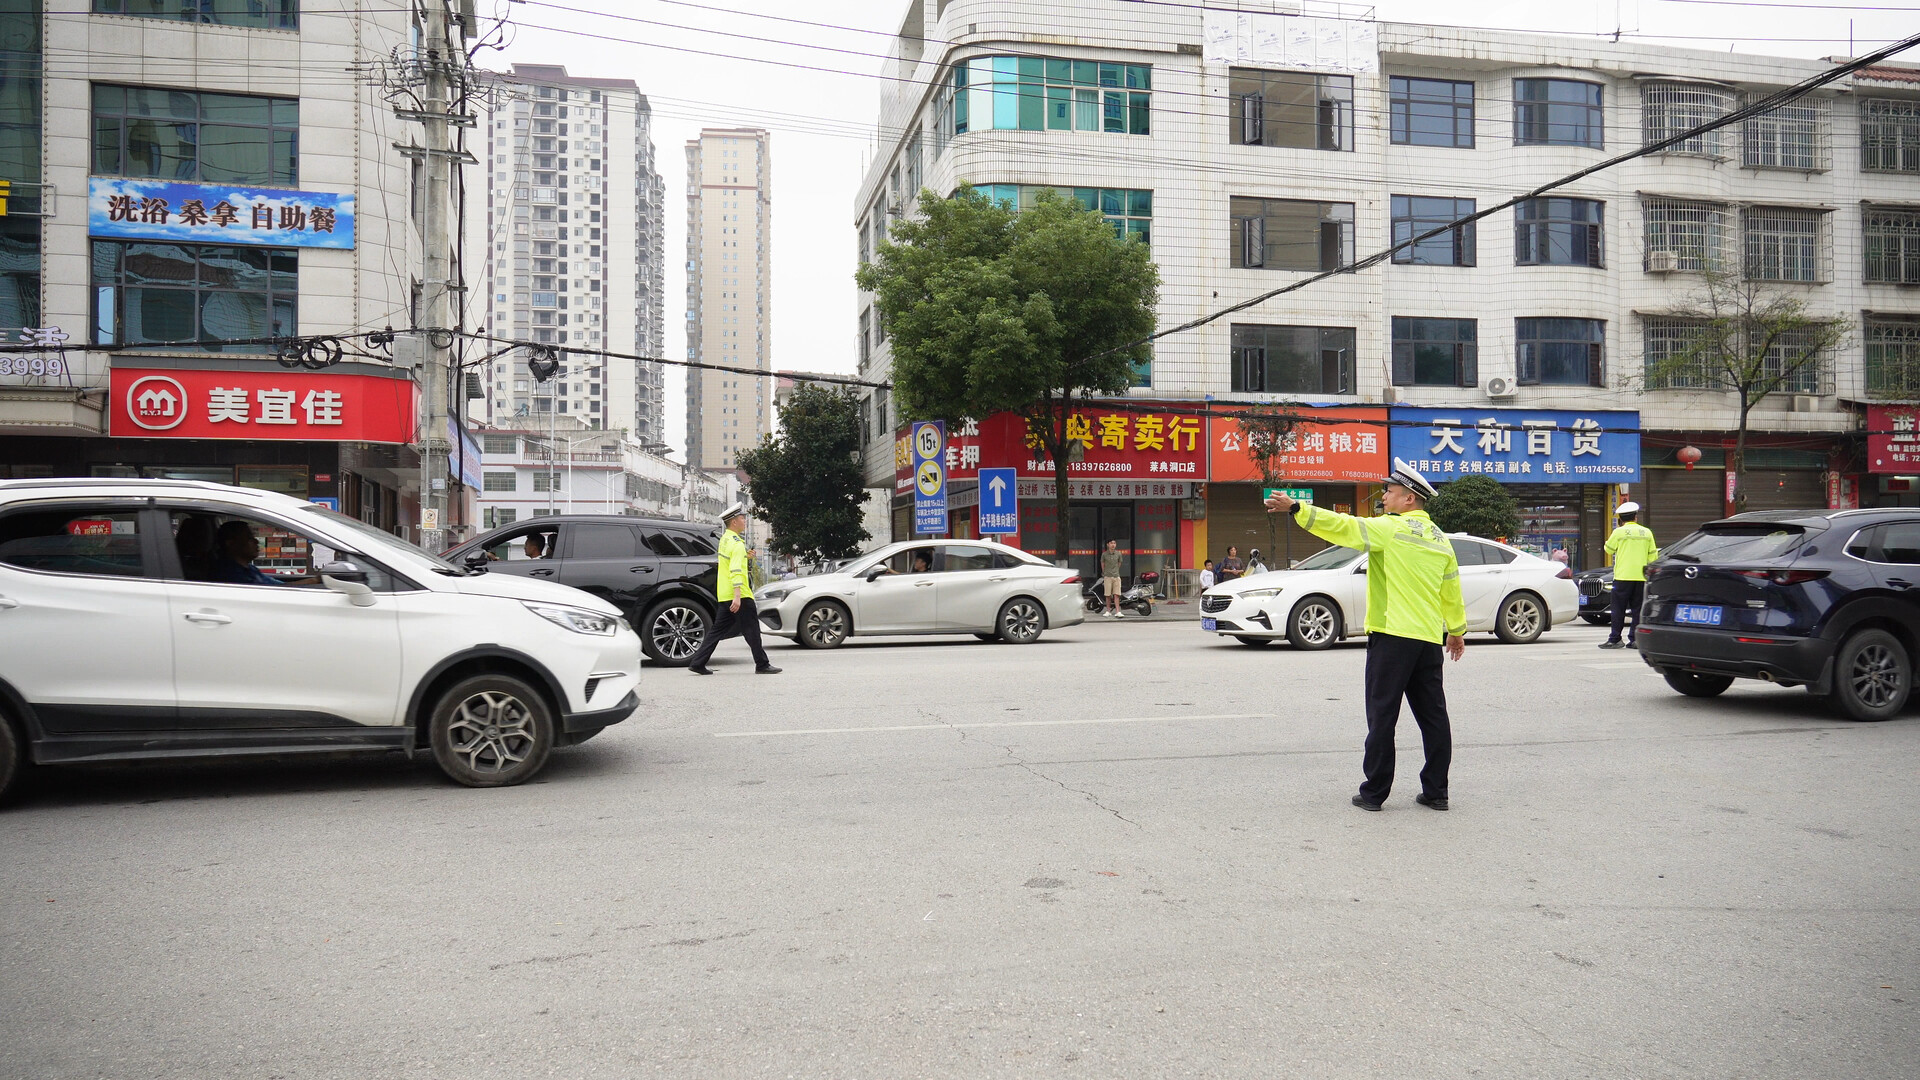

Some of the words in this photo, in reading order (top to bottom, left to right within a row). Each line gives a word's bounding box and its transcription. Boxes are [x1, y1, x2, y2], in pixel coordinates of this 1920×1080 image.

[107, 194, 170, 225] 洗浴
[178, 199, 239, 228] 桑拿
[251, 203, 337, 234] 自助餐
[207, 386, 343, 425] 美宜佳
[920, 433, 937, 451] 15t
[1430, 417, 1604, 457] 天和百货
[1408, 460, 1455, 473] 日用百货
[1459, 460, 1506, 474] 名烟名酒
[1508, 461, 1532, 474] 副食
[1574, 465, 1627, 474] 13517425552
[1152, 483, 1166, 497] 回收
[981, 513, 1016, 528] 太平路单向通行
